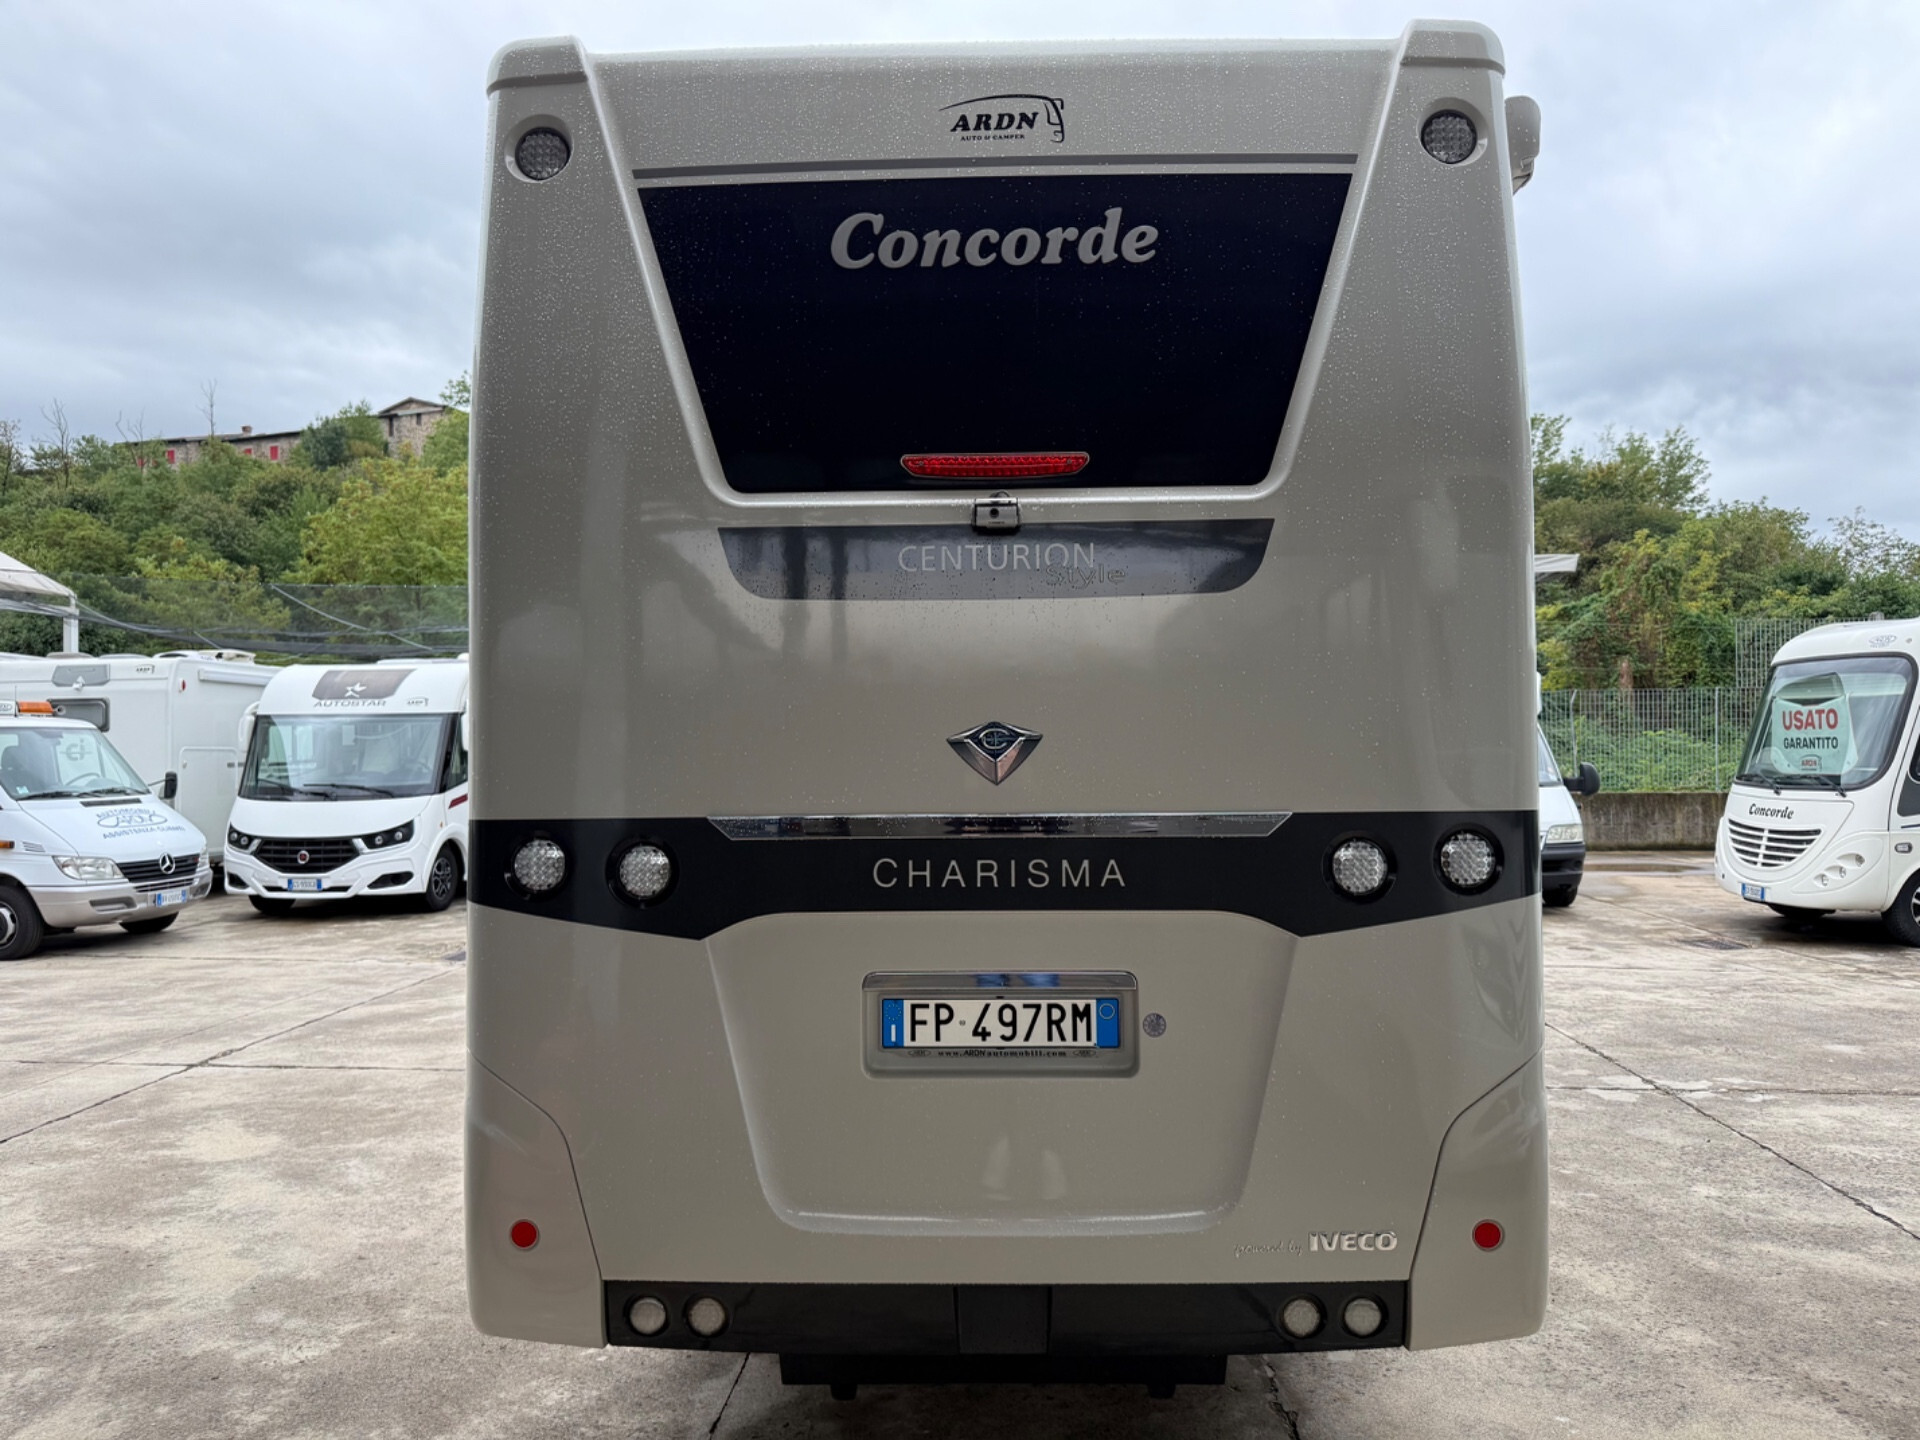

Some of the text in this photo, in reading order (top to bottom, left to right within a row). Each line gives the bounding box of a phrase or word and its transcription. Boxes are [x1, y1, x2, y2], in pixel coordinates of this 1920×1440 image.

[951, 112, 1039, 132] ARDN
[830, 207, 1159, 269] Concorde
[898, 542, 1095, 573] CENTURION
[1046, 564, 1127, 590] Style
[313, 699, 387, 708] AUTOSTAR
[1782, 708, 1839, 731] USATO
[1783, 736, 1839, 749] GARANTITO
[1749, 803, 1794, 819] Concorde
[873, 858, 1126, 888] CHARISMA
[910, 1003, 1093, 1042] FP 497RM
[1233, 1231, 1398, 1259] powered by IVECO
